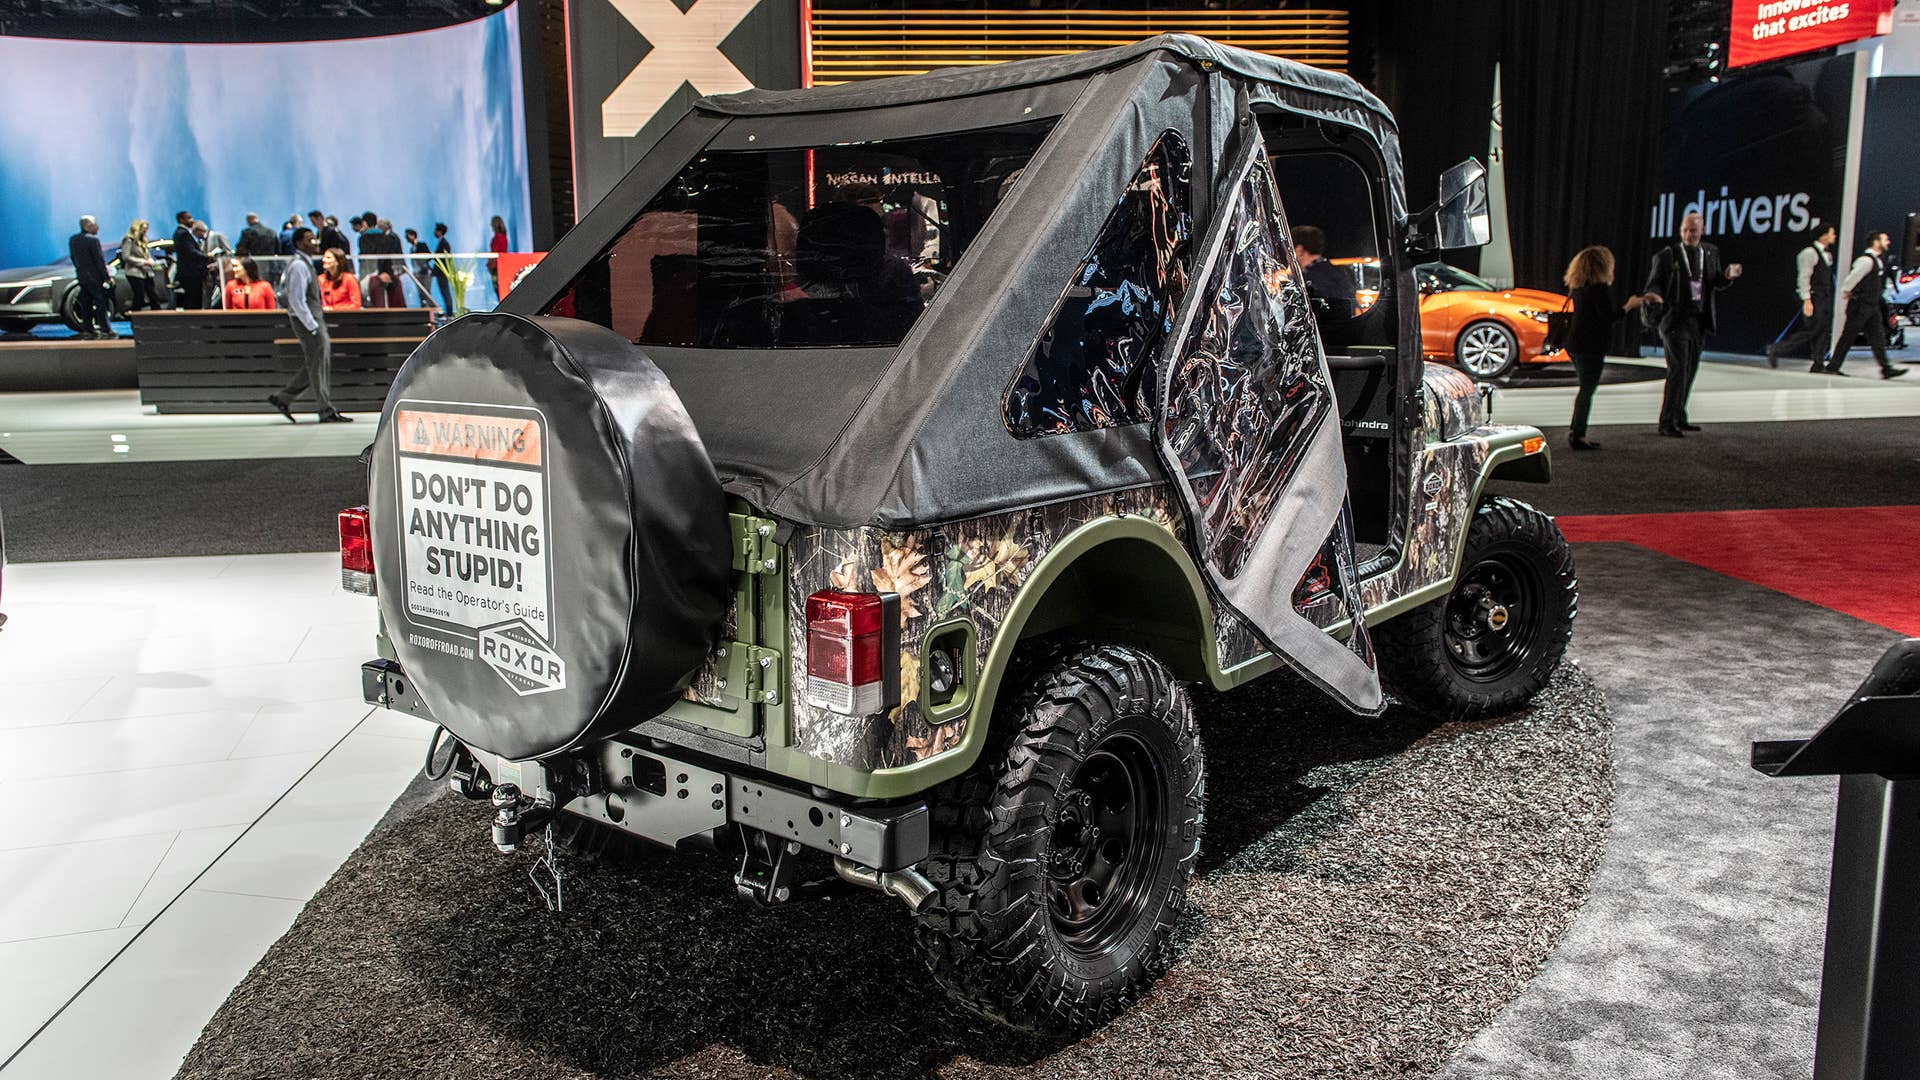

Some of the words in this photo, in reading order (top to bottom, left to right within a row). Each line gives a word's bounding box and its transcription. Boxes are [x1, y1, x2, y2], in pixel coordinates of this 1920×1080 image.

[1752, 17, 1787, 40] that
[1788, 3, 1850, 31] excites
[433, 421, 526, 453] WARNING
[411, 471, 487, 508] DON'T
[494, 481, 533, 516] DO
[409, 507, 541, 556] ANYTHING
[426, 546, 523, 592] STUPID!
[410, 580, 434, 597] Read
[437, 587, 453, 601] the
[455, 590, 511, 614] Operator's
[513, 602, 545, 621] Guide
[409, 633, 475, 660] ROXOROFFROAD.COM
[483, 636, 561, 683] ROXOR
